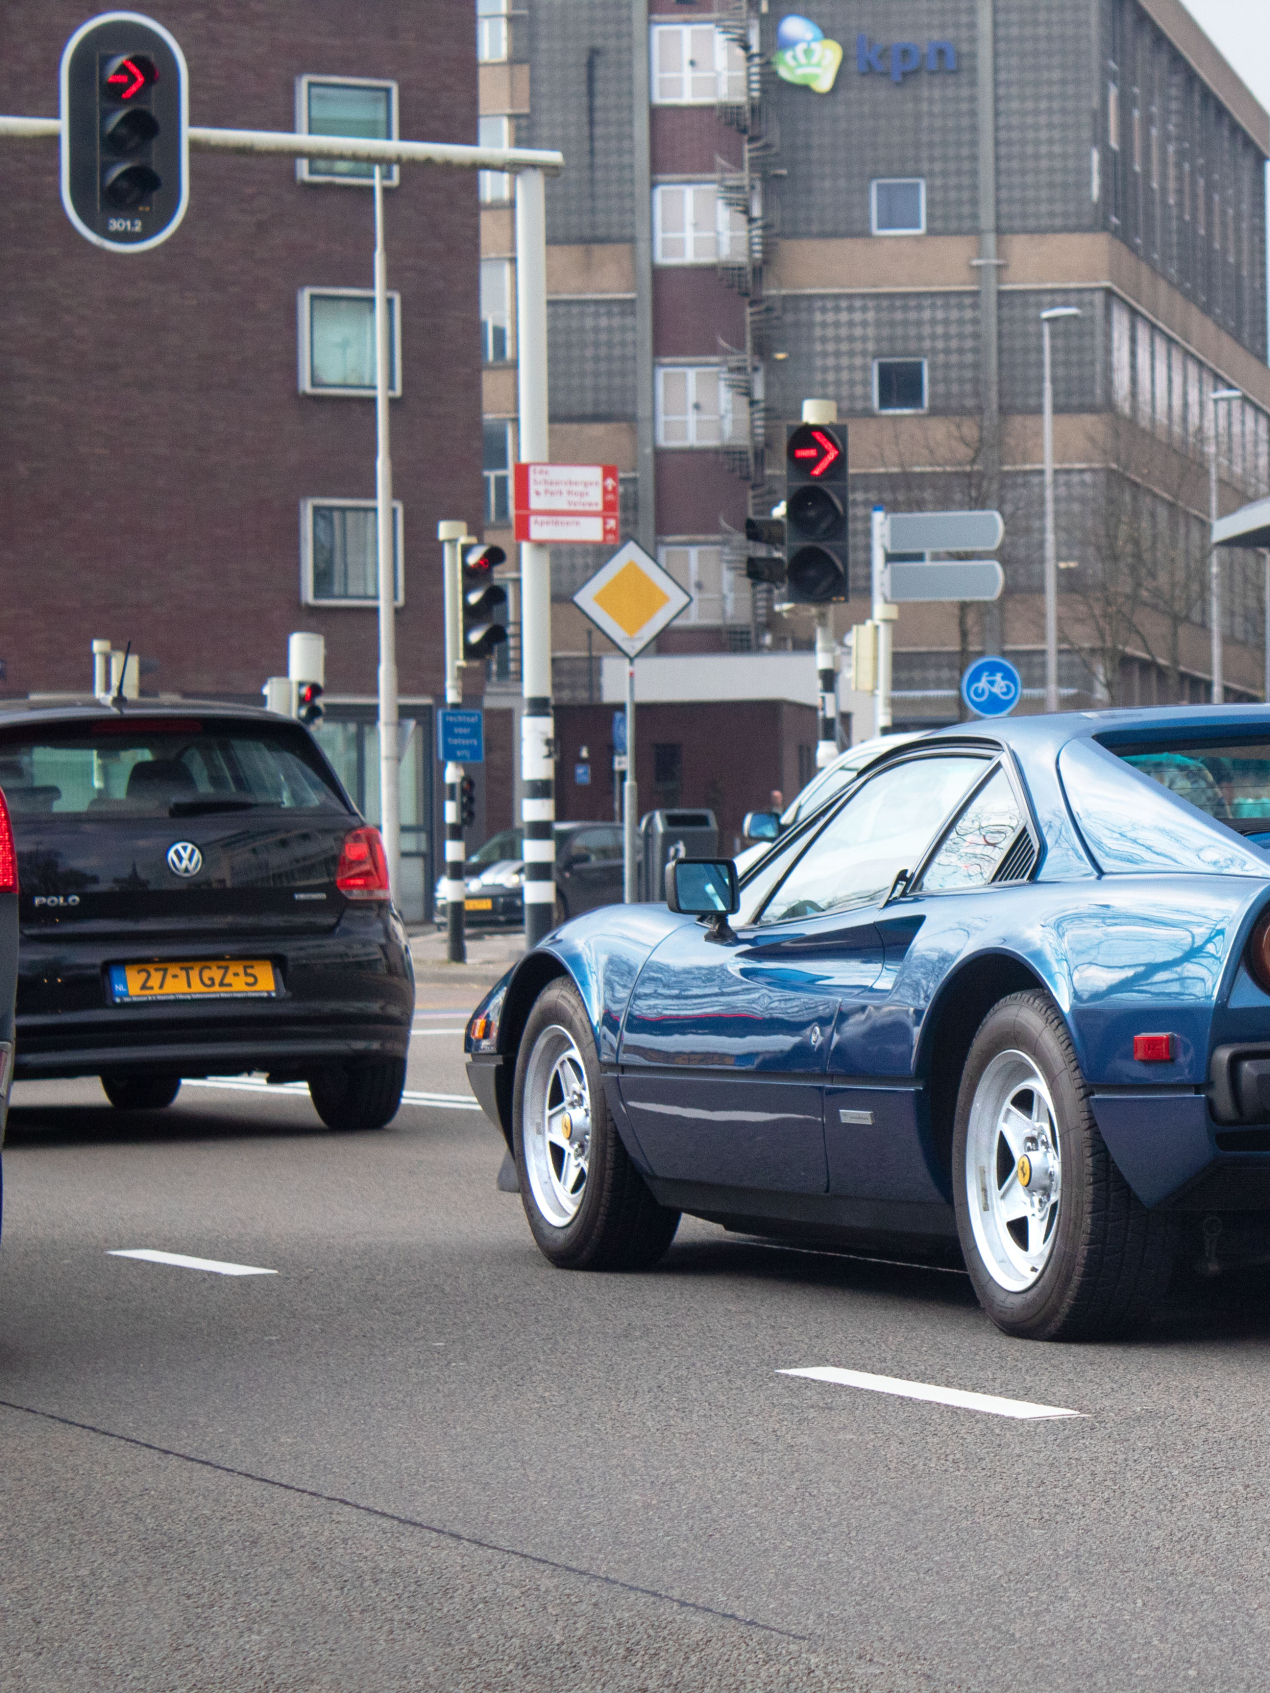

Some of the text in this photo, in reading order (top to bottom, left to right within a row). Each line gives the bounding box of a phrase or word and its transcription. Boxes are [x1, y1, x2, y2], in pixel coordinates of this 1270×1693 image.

[856, 33, 957, 82] kpn
[108, 218, 143, 232] 301.2
[544, 489, 563, 497] Park
[34, 895, 80, 907] POLO
[115, 964, 259, 992] NL 27-TGZ-5
